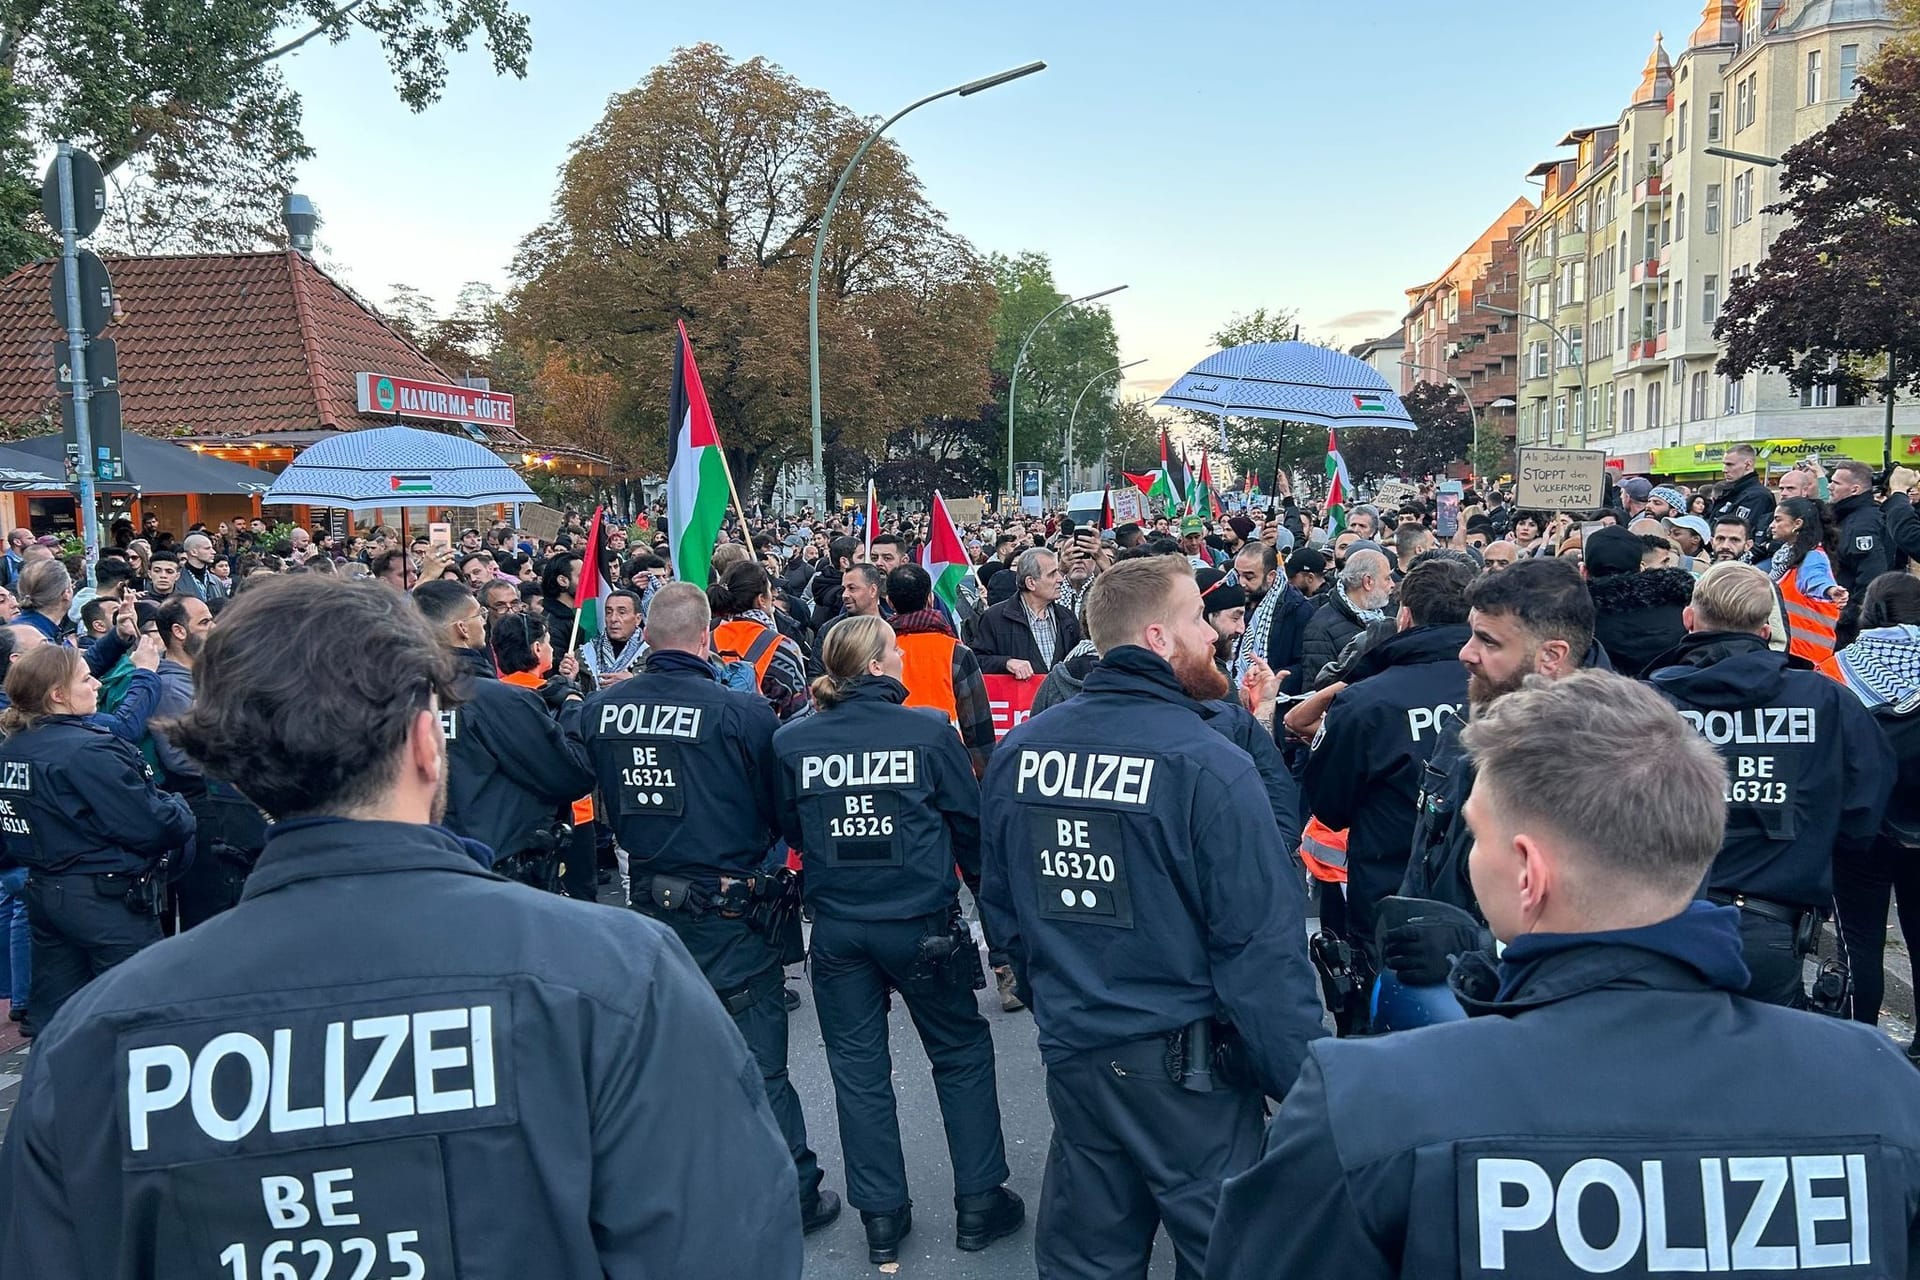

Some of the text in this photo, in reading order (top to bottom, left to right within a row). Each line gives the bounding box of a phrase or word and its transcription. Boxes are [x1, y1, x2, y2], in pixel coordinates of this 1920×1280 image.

[400, 387, 511, 421] KAVURMA-KÖFTE
[1773, 443, 1836, 456] Apotheke
[1523, 468, 1588, 480] STOPPT den
[1559, 494, 1592, 507] GAZA!
[438, 711, 456, 739] EI
[600, 704, 701, 738] POLIZEI
[632, 747, 658, 766] BE
[802, 751, 914, 789] POLIZEI
[1738, 756, 1774, 778] BE
[0, 762, 30, 790] IZEI
[622, 768, 676, 787] 16321
[1017, 750, 1155, 804] POLIZEI
[845, 795, 874, 814] BE
[830, 816, 893, 837] 16326
[1056, 818, 1090, 848] BE
[1040, 850, 1115, 882] 16320
[128, 1005, 496, 1151] POLIZEI
[261, 1168, 360, 1229] BE
[1477, 1154, 1871, 1273] POLIZEI
[219, 1230, 425, 1280] 16225
